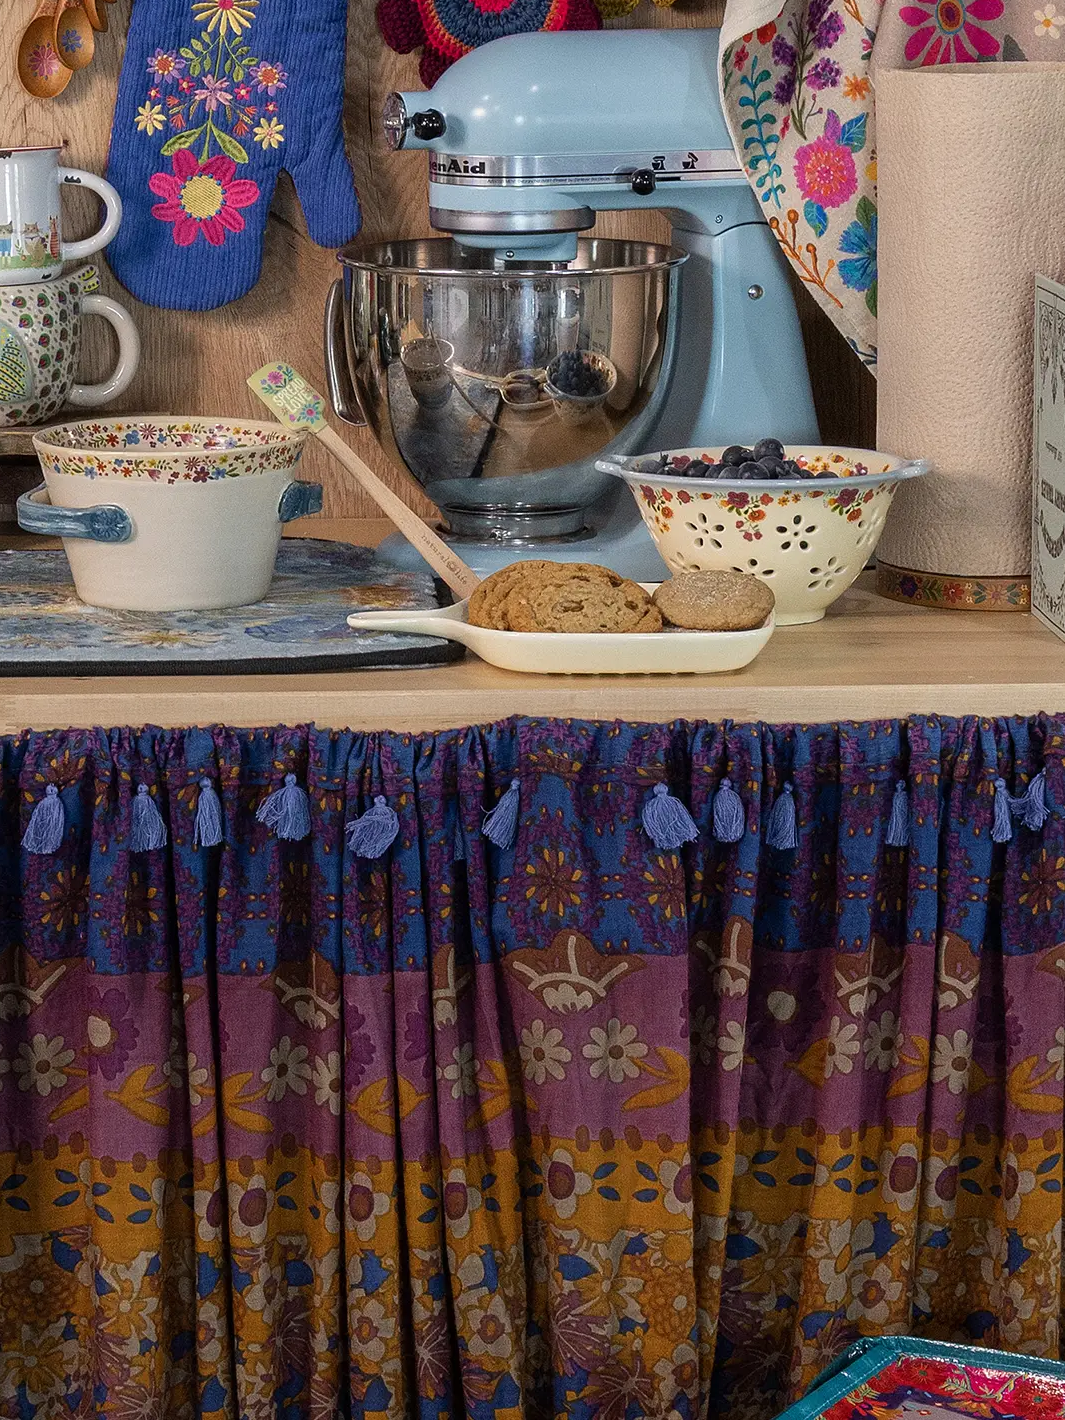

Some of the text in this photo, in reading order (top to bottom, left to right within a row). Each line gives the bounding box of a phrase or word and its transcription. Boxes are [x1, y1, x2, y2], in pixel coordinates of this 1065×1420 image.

[429, 159, 486, 175] enAid
[272, 377, 306, 408] SPREAD
[284, 388, 312, 414] LOVE
[421, 535, 468, 585] natural life
